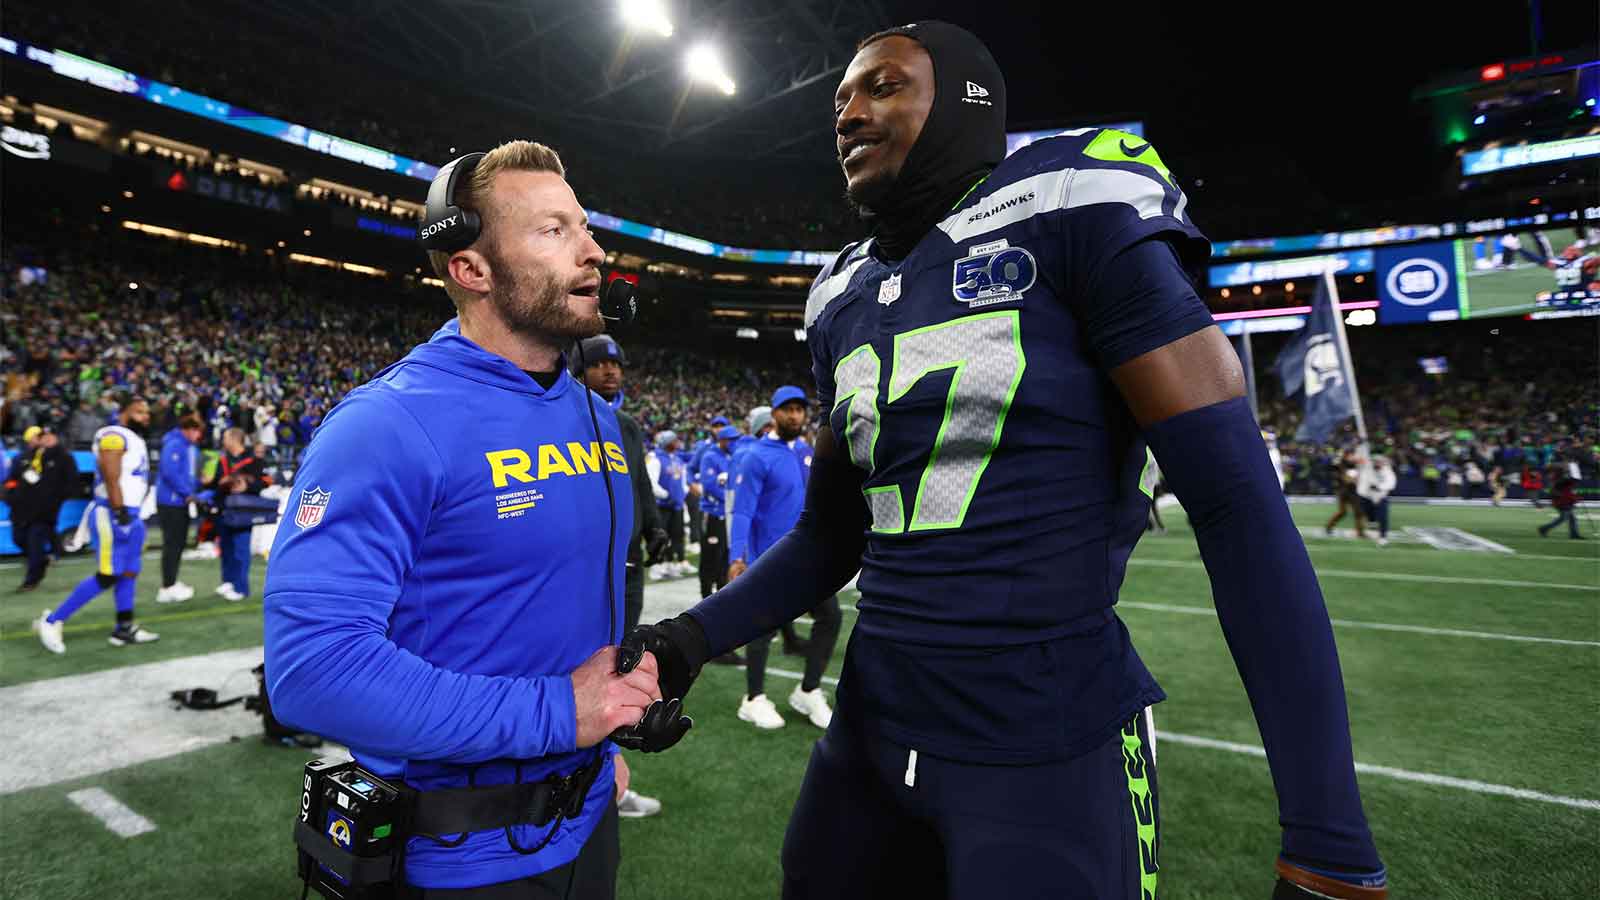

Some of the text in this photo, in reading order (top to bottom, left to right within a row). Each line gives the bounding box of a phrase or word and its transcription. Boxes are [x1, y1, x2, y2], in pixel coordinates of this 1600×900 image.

[967, 191, 1036, 224] SEAHAWKS
[421, 215, 458, 240] SONY
[953, 247, 1038, 303] 50
[830, 310, 1027, 534] 27
[485, 441, 629, 488] RAMS
[496, 490, 527, 501] ENGINEERED
[508, 496, 530, 505] ANGELES
[530, 493, 544, 501] RAMS
[299, 506, 321, 524] NFL
[497, 510, 525, 519] NFC-WEST
